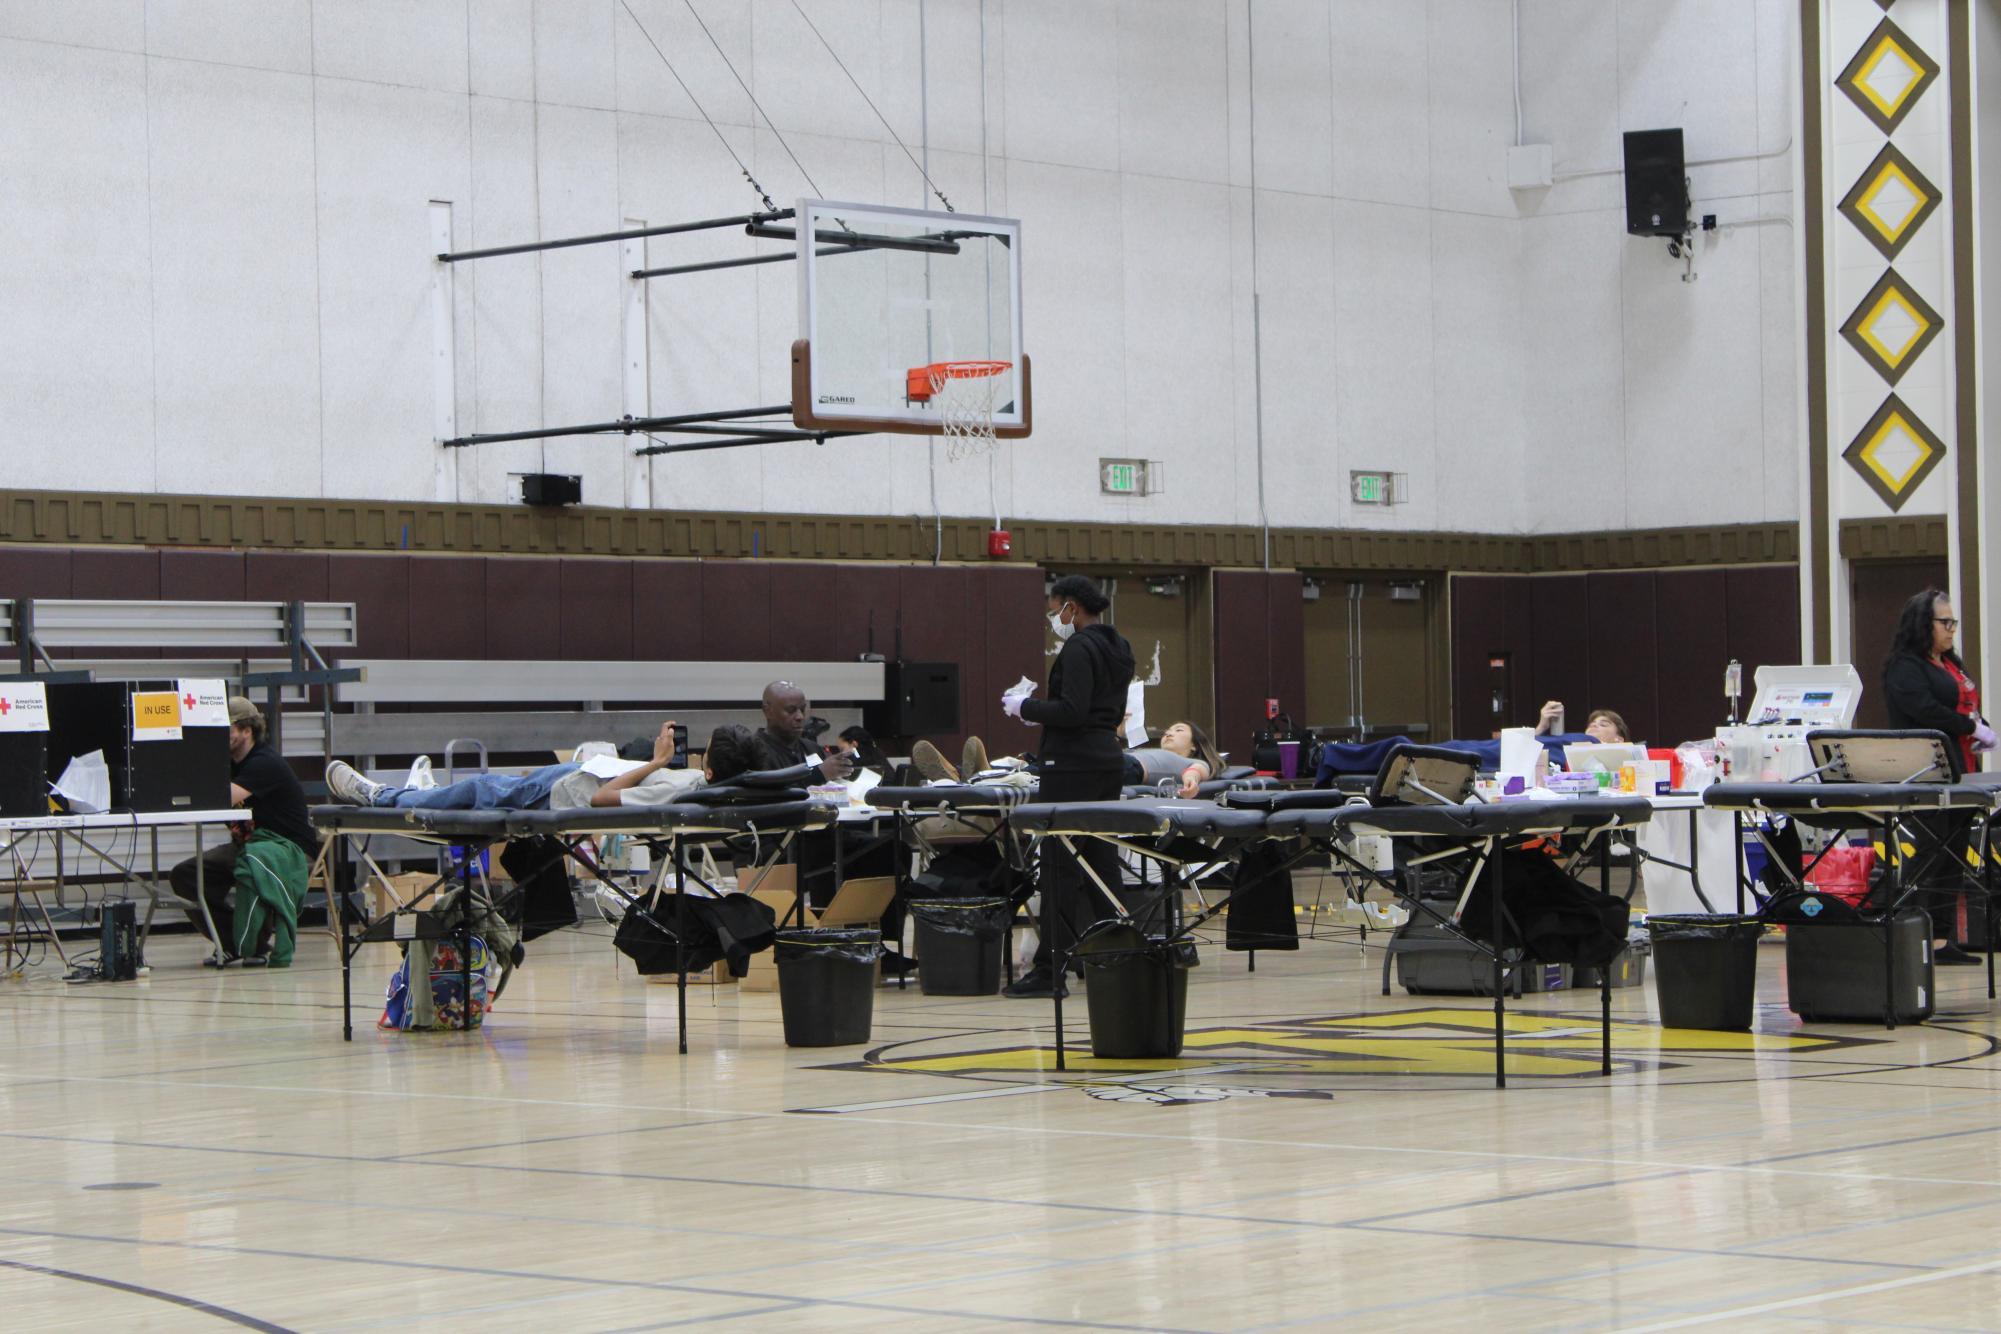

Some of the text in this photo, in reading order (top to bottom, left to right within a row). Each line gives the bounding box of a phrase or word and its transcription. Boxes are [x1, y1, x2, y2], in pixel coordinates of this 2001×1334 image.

[1112, 465, 1133, 489] EXIT
[1361, 477, 1382, 500] EXIT
[144, 705, 171, 715] IN USE
